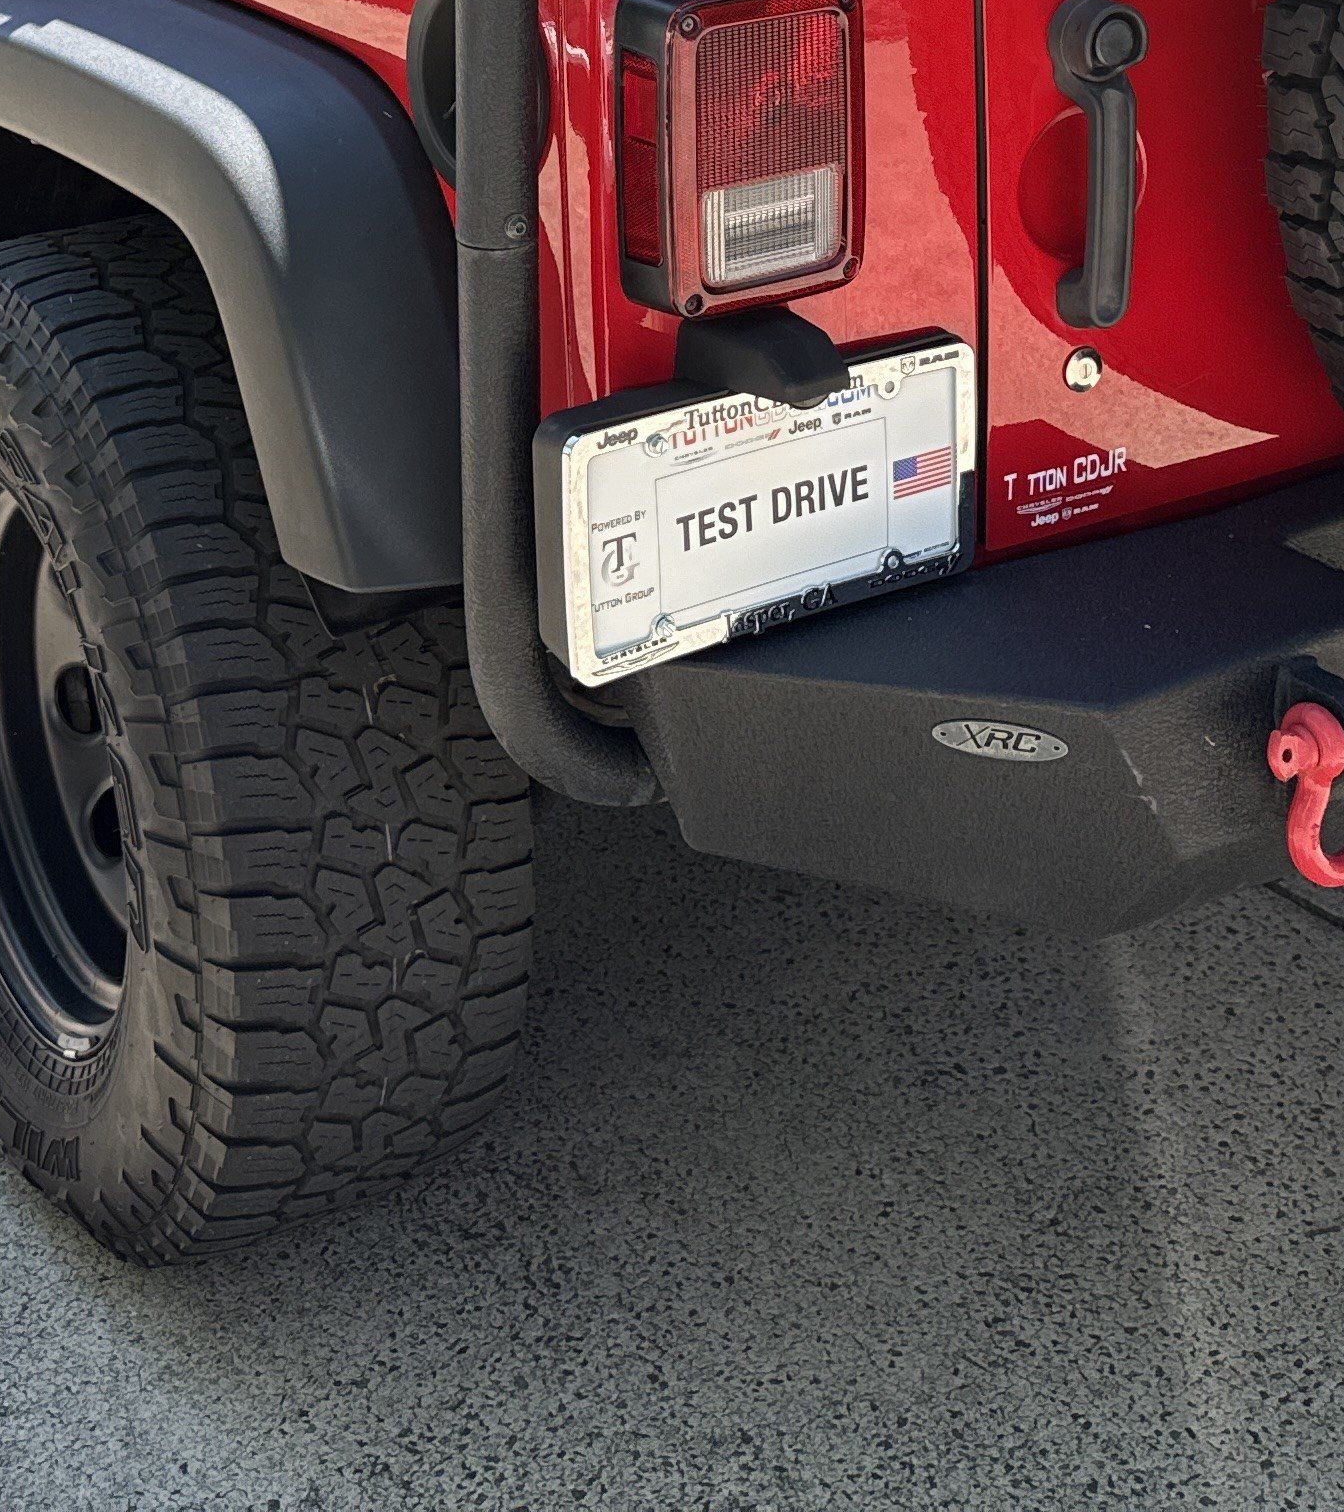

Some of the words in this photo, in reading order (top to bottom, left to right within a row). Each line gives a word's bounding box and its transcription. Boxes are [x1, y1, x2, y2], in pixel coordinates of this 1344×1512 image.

[918, 350, 960, 367] RAM
[787, 416, 822, 436] Jeep
[844, 407, 872, 420] RAM
[596, 427, 639, 450] Jeep
[1072, 446, 1128, 485] CDJR
[675, 493, 758, 552] TEST
[770, 463, 870, 525] DRIVE
[1030, 512, 1060, 527] Jeep
[1072, 503, 1100, 515] RAM
[720, 599, 796, 644] Jasper,
[799, 582, 838, 611] GA
[602, 636, 668, 665] CHRYSLER
[956, 723, 1043, 754] XRC
